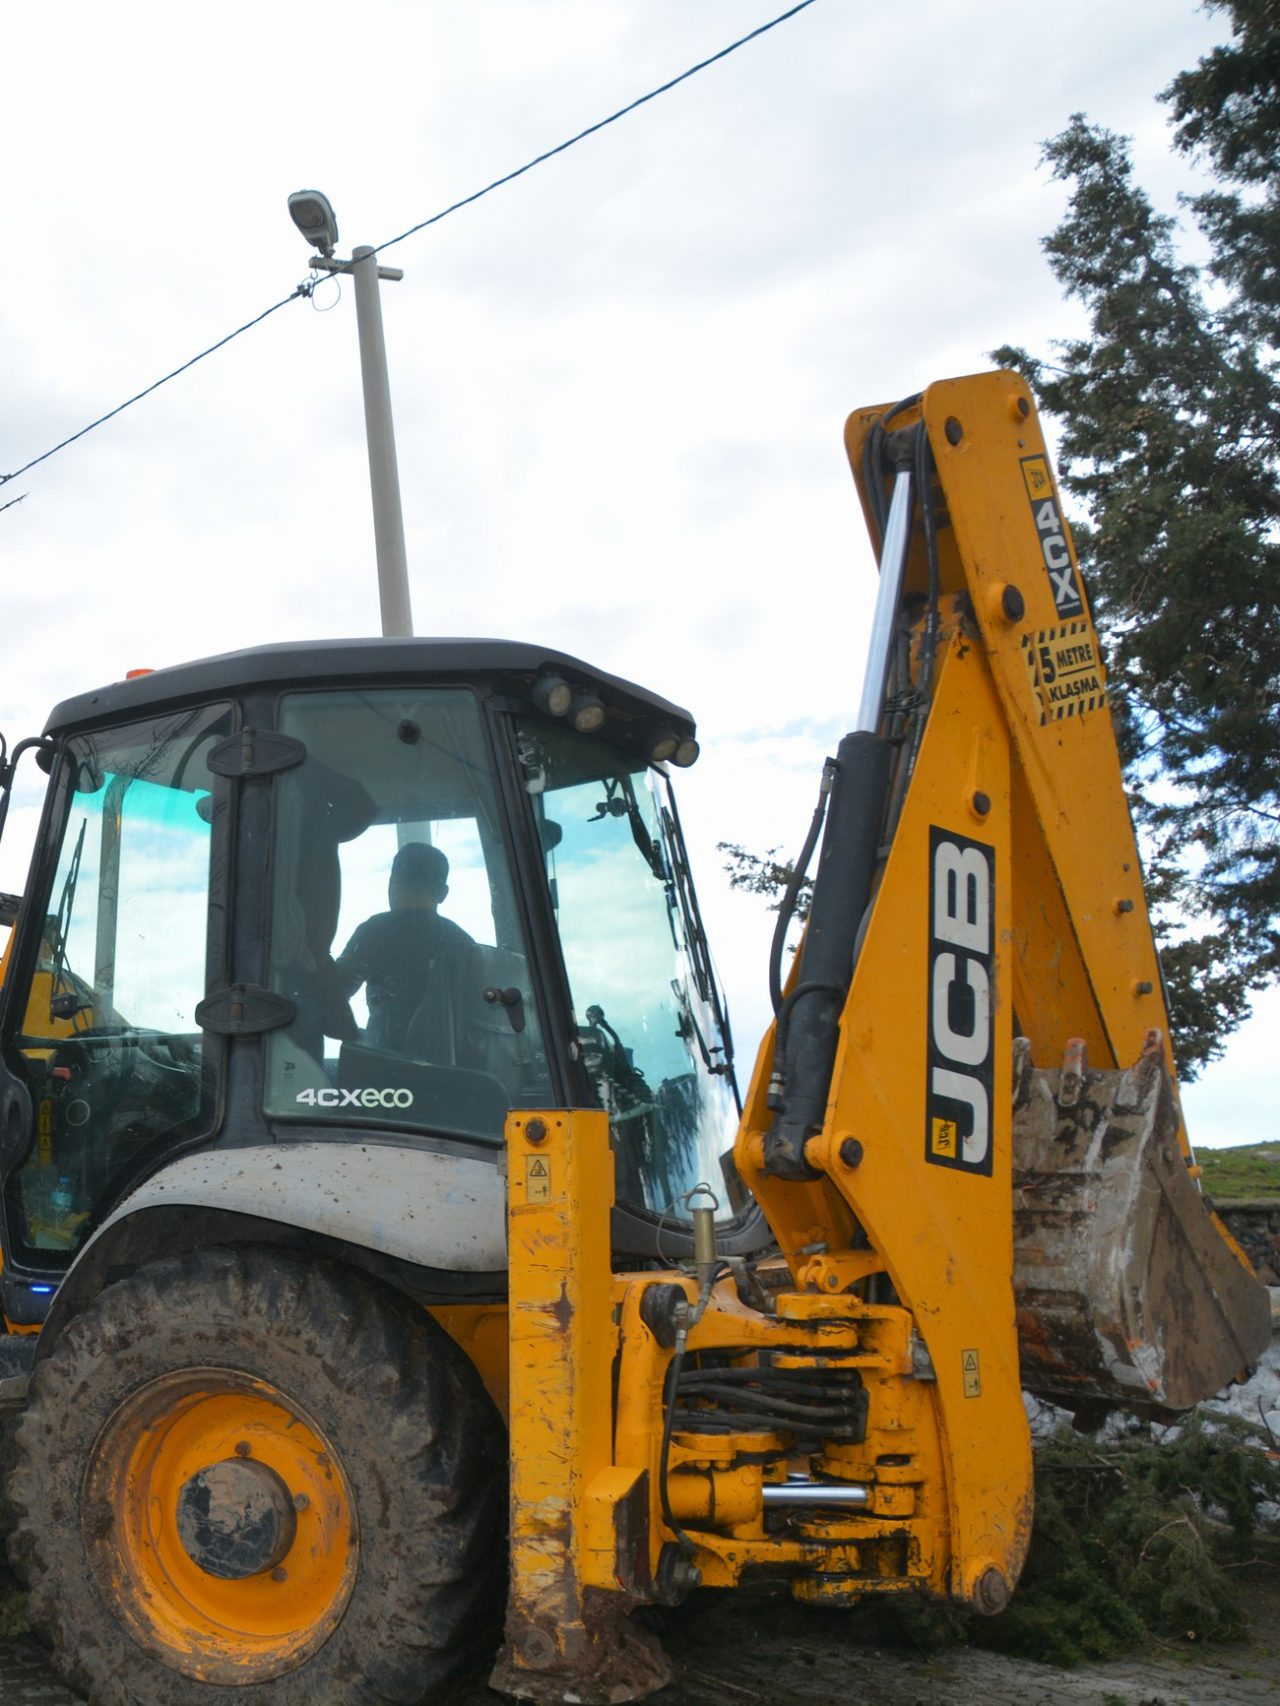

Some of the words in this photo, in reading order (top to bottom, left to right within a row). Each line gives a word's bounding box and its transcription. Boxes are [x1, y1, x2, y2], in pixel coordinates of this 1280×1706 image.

[1036, 501, 1080, 603] 4CX
[1056, 643, 1093, 669] METRE
[932, 841, 990, 1164] JCB
